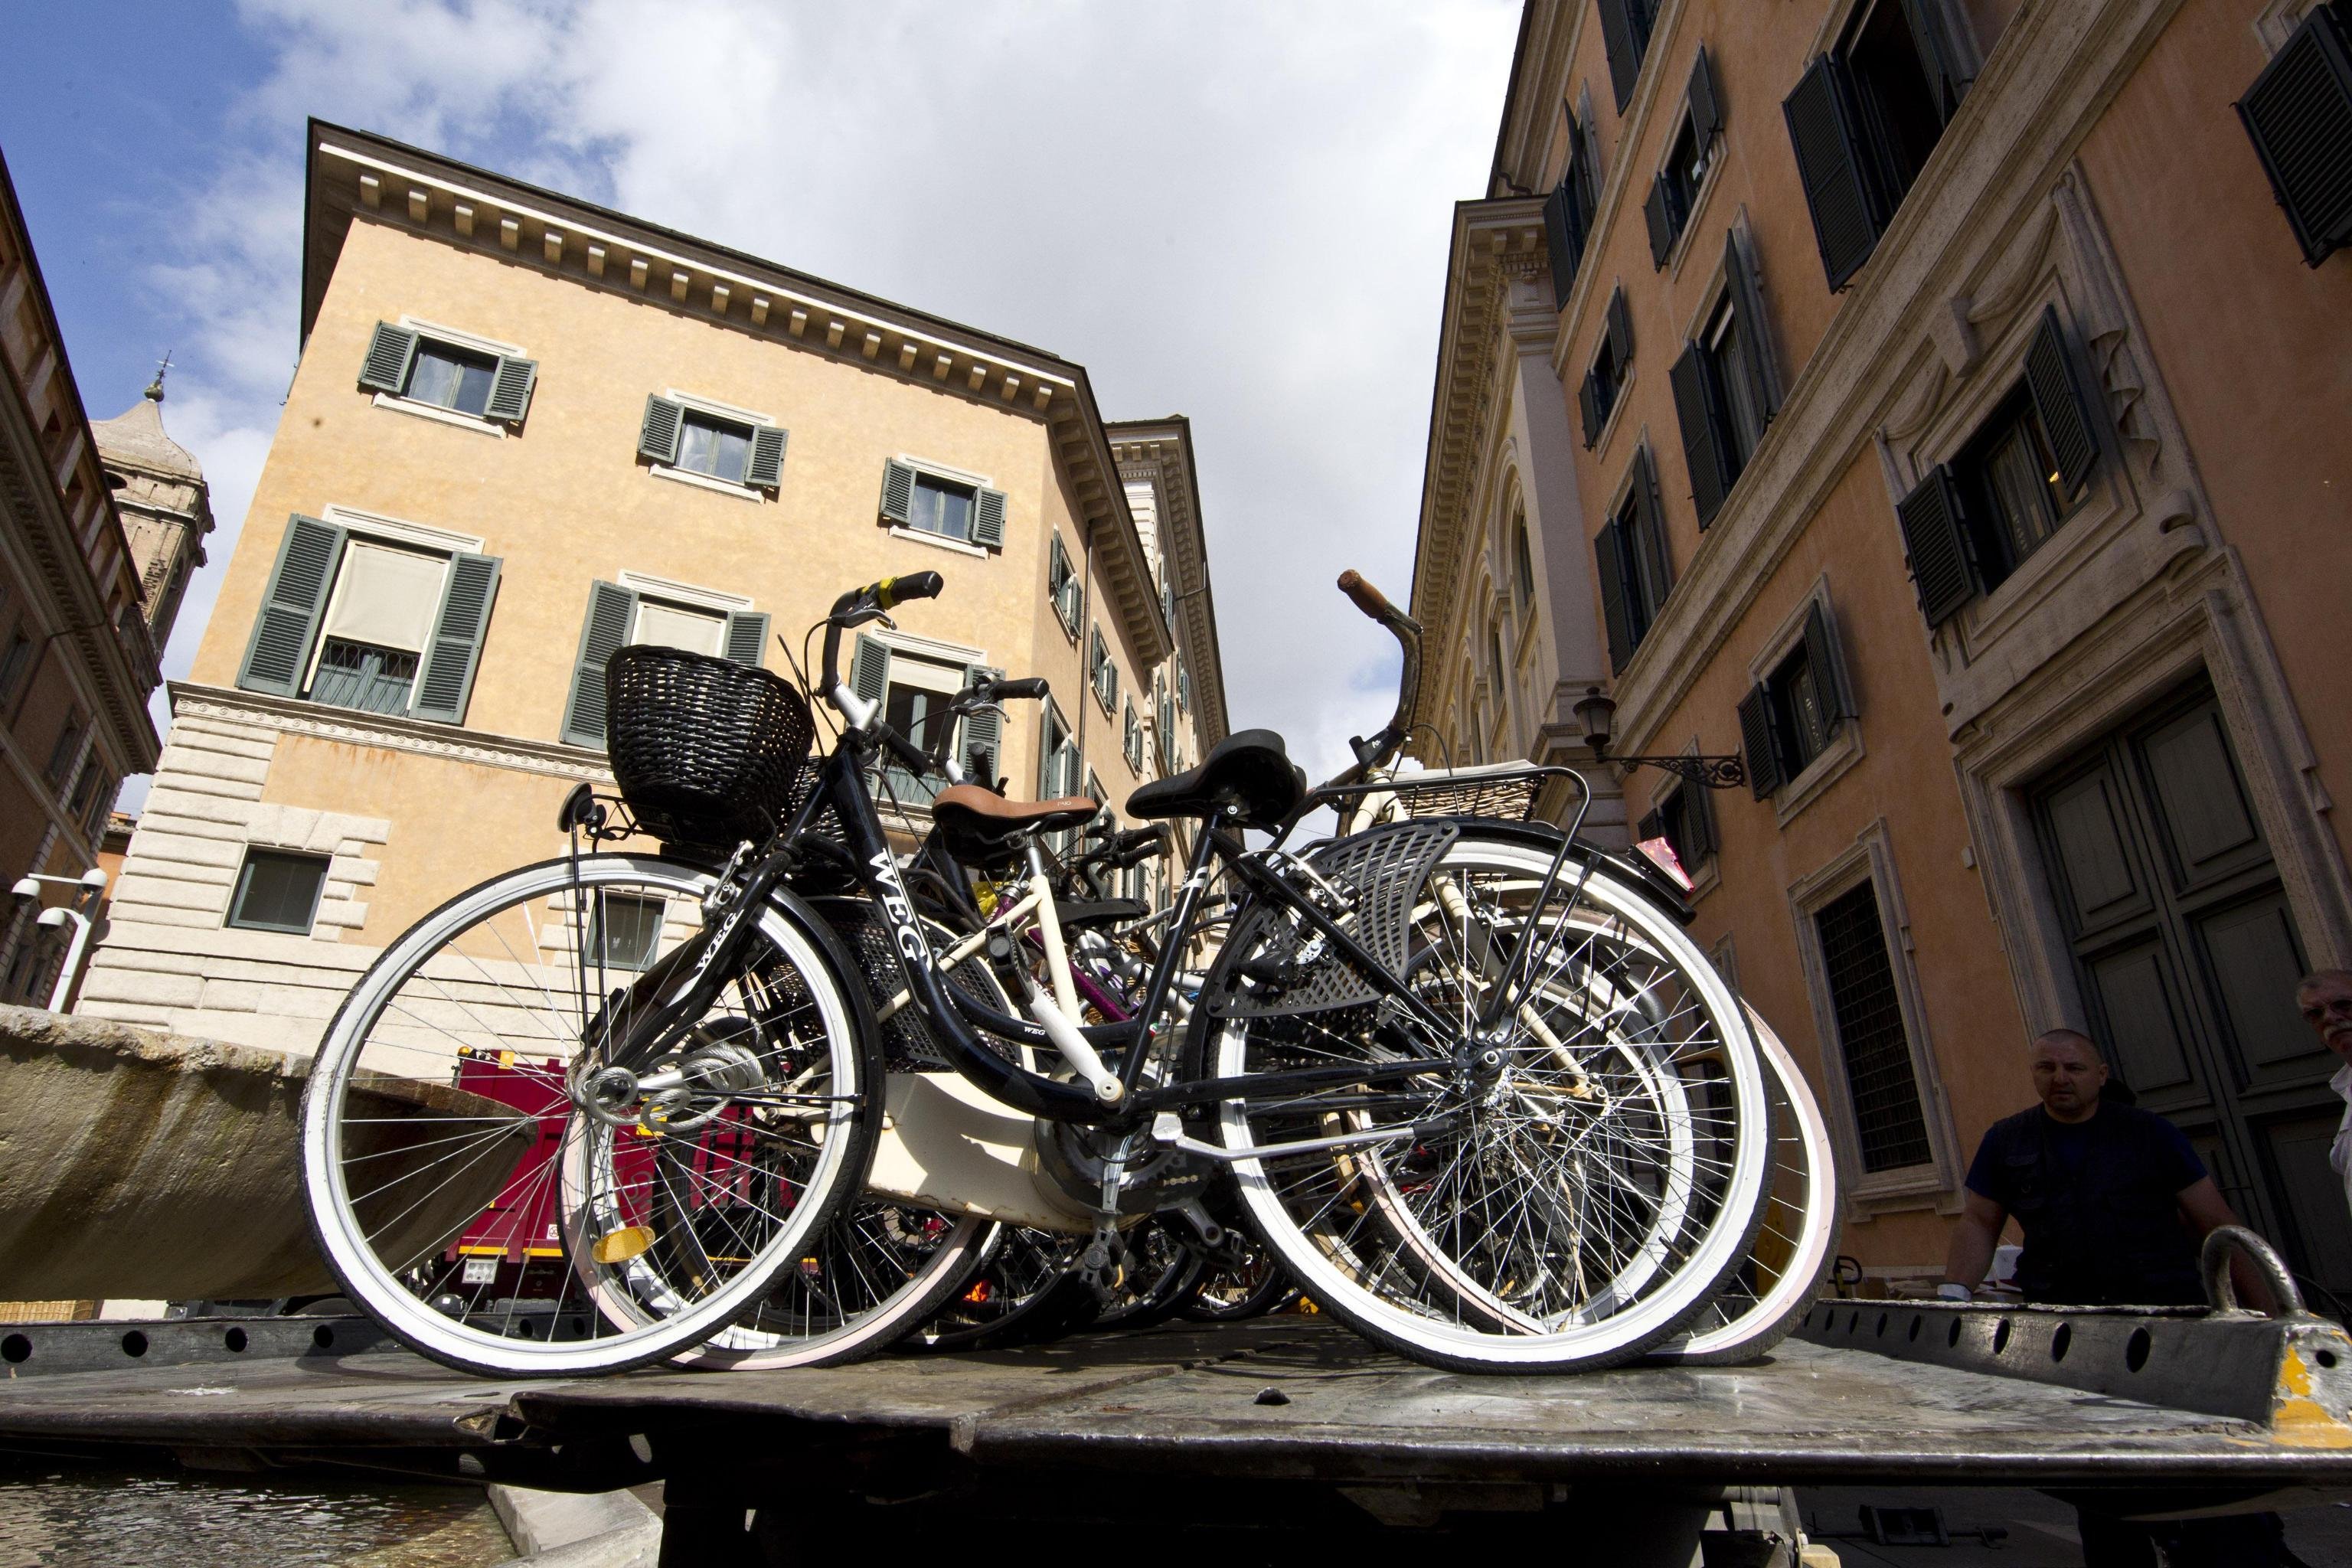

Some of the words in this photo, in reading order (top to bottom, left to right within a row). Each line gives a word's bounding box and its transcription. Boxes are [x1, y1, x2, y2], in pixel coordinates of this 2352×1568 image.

[869, 848, 927, 961] WEG
[694, 912, 737, 970] WEG
[1024, 1026, 1046, 1036] WEG
